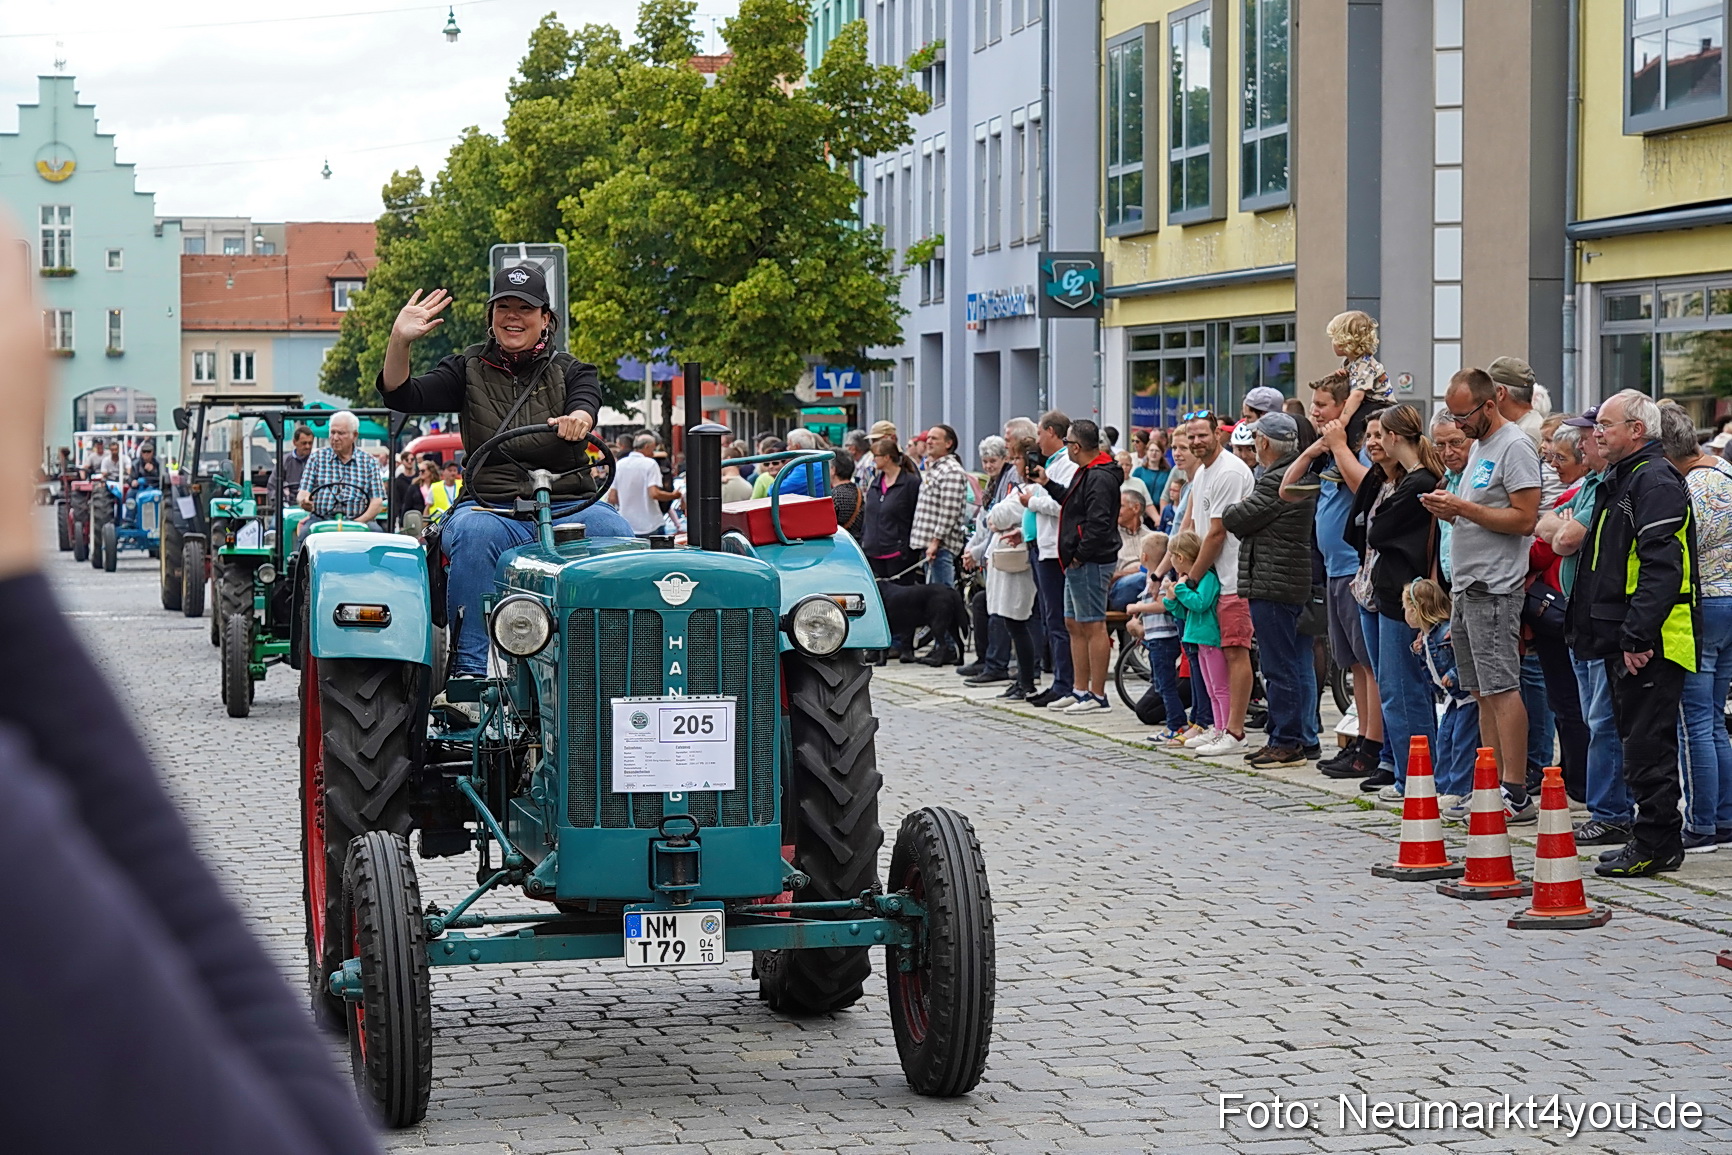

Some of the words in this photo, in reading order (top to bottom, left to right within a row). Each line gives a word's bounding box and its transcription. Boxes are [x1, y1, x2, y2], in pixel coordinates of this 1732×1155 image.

[1062, 269, 1085, 297] G2
[673, 714, 714, 735] 205
[646, 916, 677, 938] NM
[699, 939, 714, 949] 04
[700, 952, 714, 963] 10
